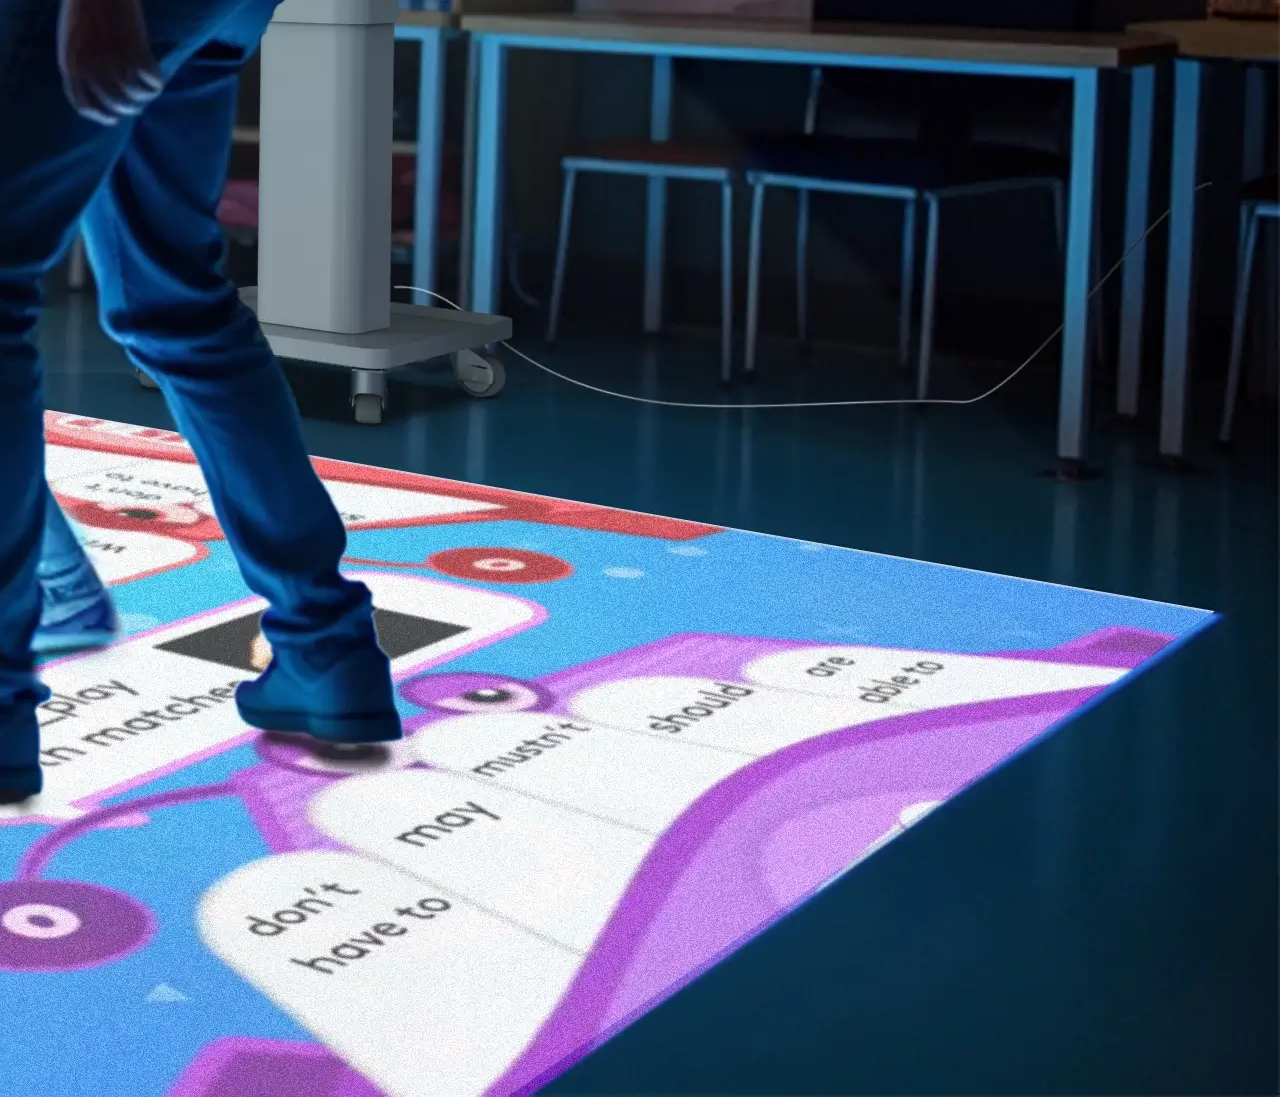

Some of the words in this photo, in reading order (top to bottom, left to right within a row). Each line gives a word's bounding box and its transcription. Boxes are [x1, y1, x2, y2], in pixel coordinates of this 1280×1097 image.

[806, 657, 856, 678] are
[858, 675, 921, 705] able
[902, 661, 945, 676] to
[647, 683, 755, 735] should
[472, 720, 592, 779] mustn't
[394, 800, 502, 848] may
[246, 881, 362, 939] don't
[290, 920, 409, 976] have
[395, 896, 452, 921] to
